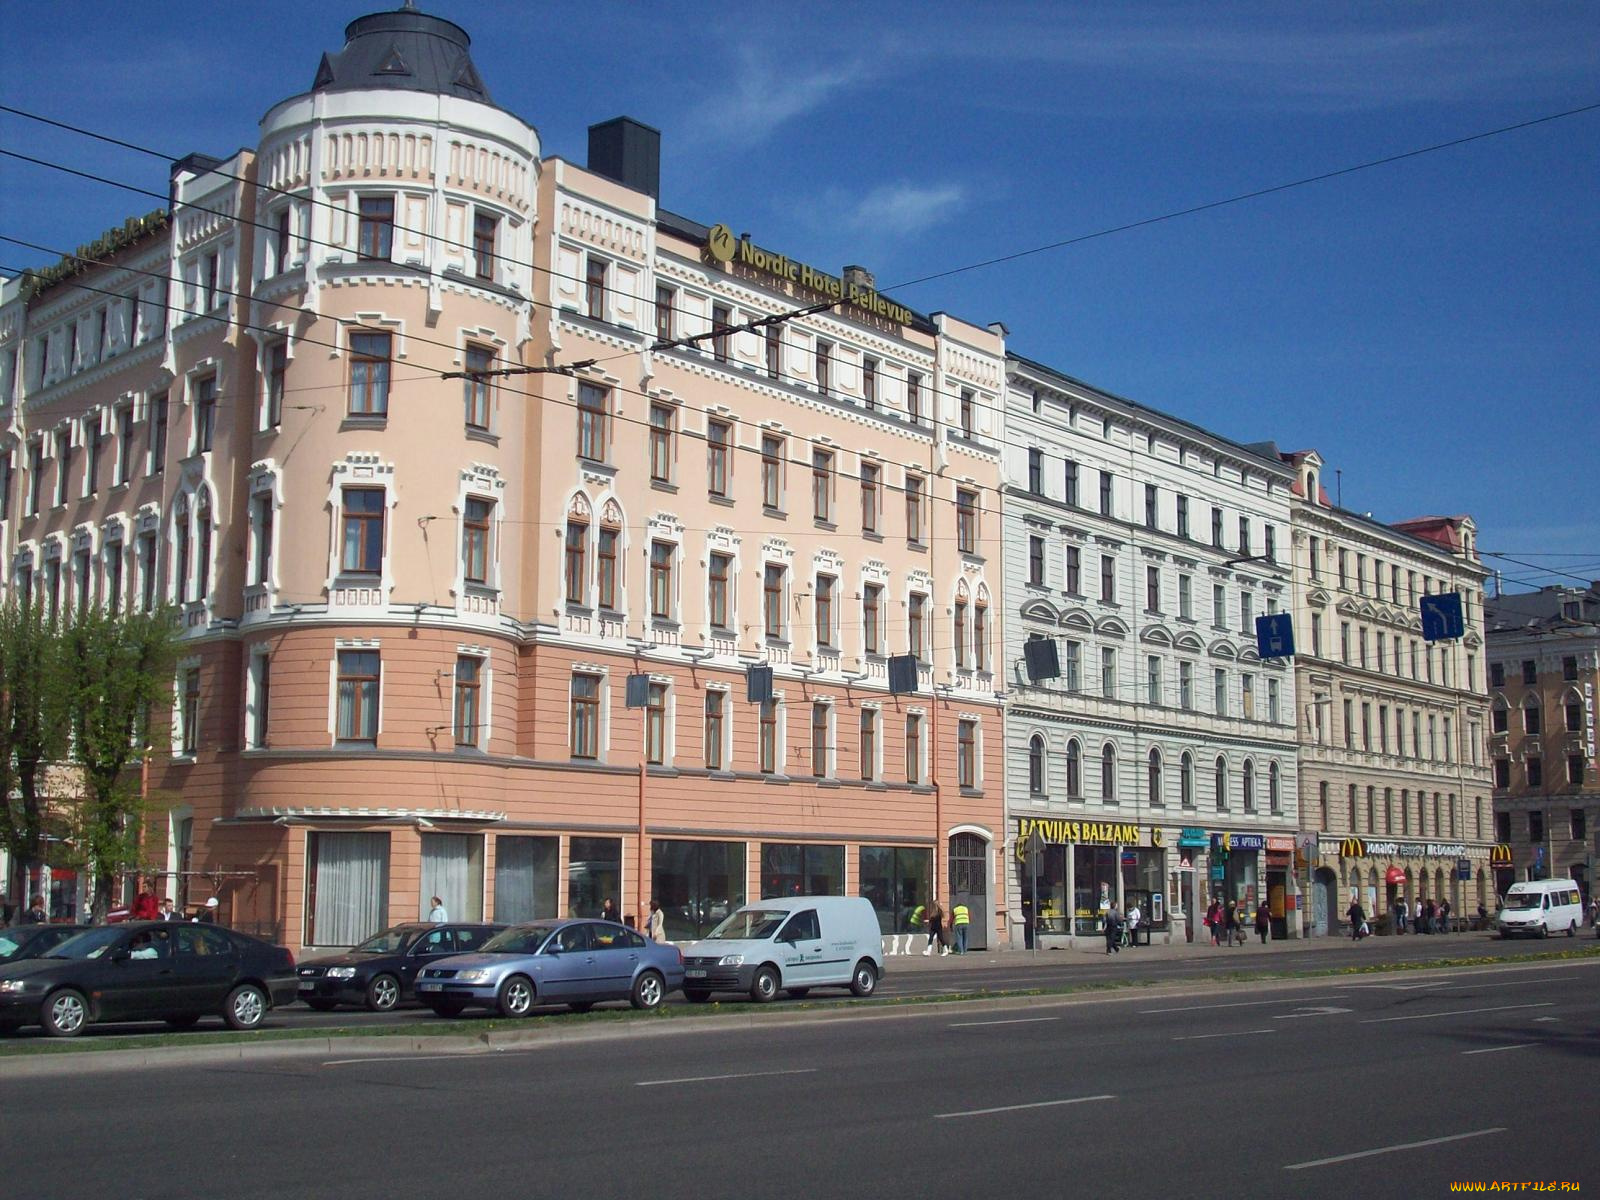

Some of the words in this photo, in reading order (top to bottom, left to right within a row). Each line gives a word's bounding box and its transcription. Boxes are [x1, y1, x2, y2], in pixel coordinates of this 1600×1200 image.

[741, 240, 798, 281] Nordic
[801, 264, 844, 299] Hotel
[849, 283, 913, 326] Bellevue
[1082, 823, 1139, 843] BALZAMS
